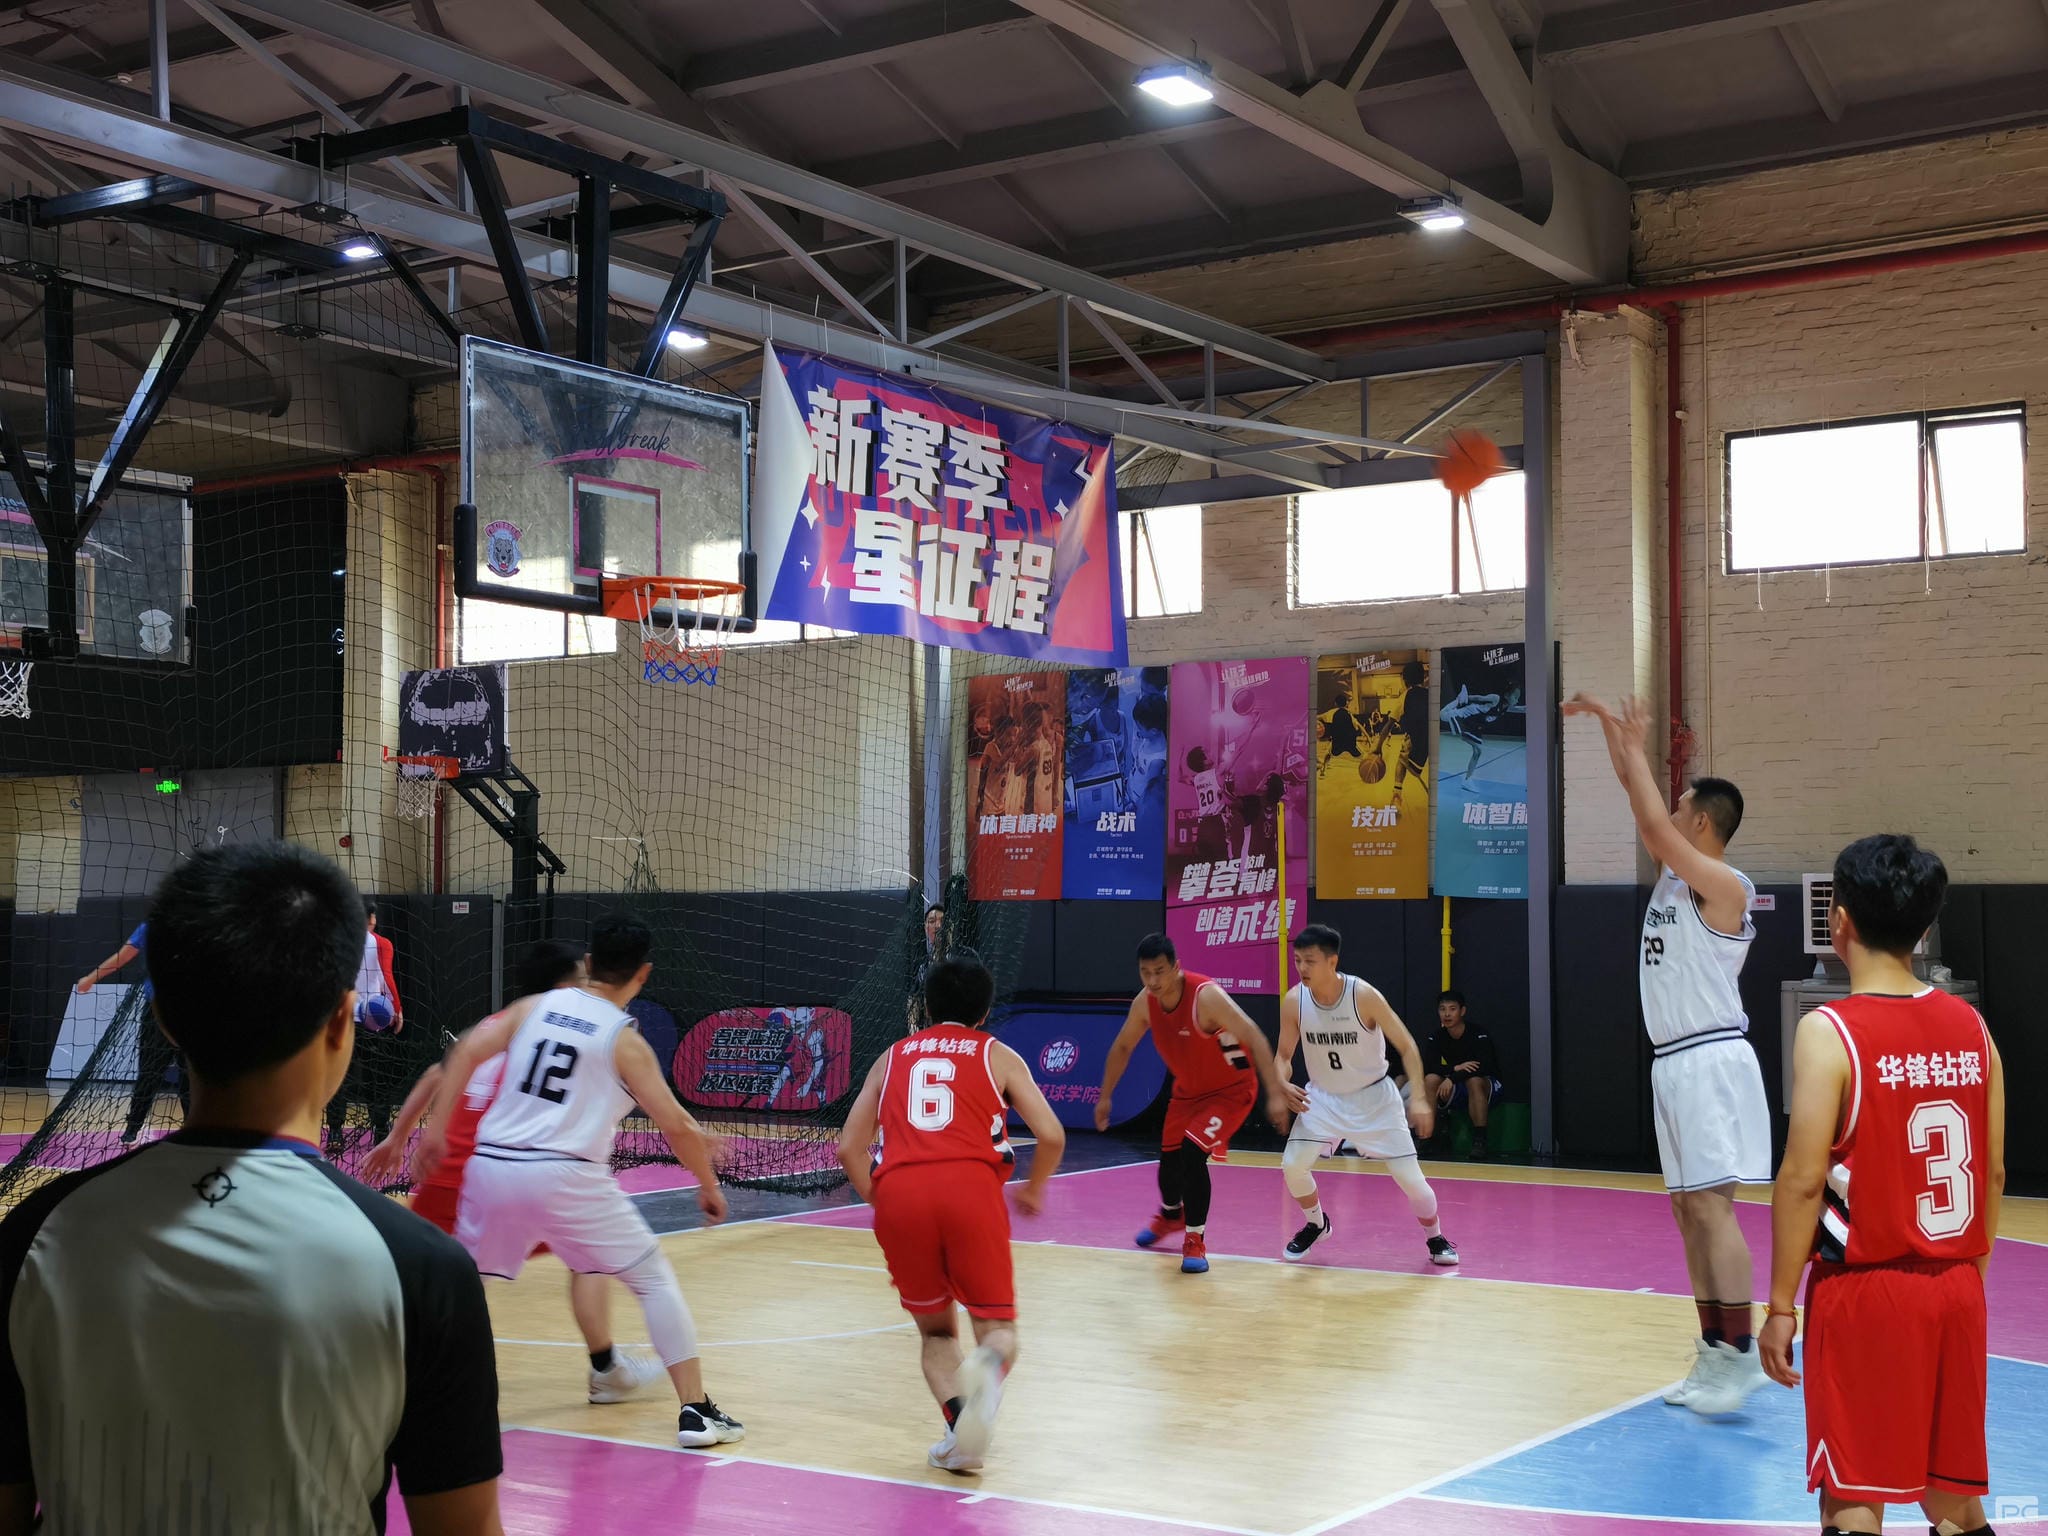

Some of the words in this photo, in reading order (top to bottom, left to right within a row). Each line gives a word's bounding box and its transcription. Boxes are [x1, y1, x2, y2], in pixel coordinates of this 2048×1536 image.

[808, 385, 1008, 520] 新赛季
[849, 507, 1055, 634] 星征程
[1200, 789, 1215, 807] 20
[979, 812, 1057, 835] 体育精神
[1096, 811, 1137, 832] 战术
[1351, 805, 1398, 828] 技术
[1178, 858, 1242, 902] 攀登
[1237, 868, 1278, 896] 高峰
[1195, 906, 1235, 933] 创造
[901, 1037, 979, 1057] 华锋钻探
[1328, 1051, 1343, 1070] 8
[518, 1037, 580, 1105] 12
[1875, 1050, 1983, 1090] 华锋钻探
[907, 1057, 956, 1132] 6
[1203, 1116, 1223, 1138] 2
[1906, 1098, 1975, 1241] 3
